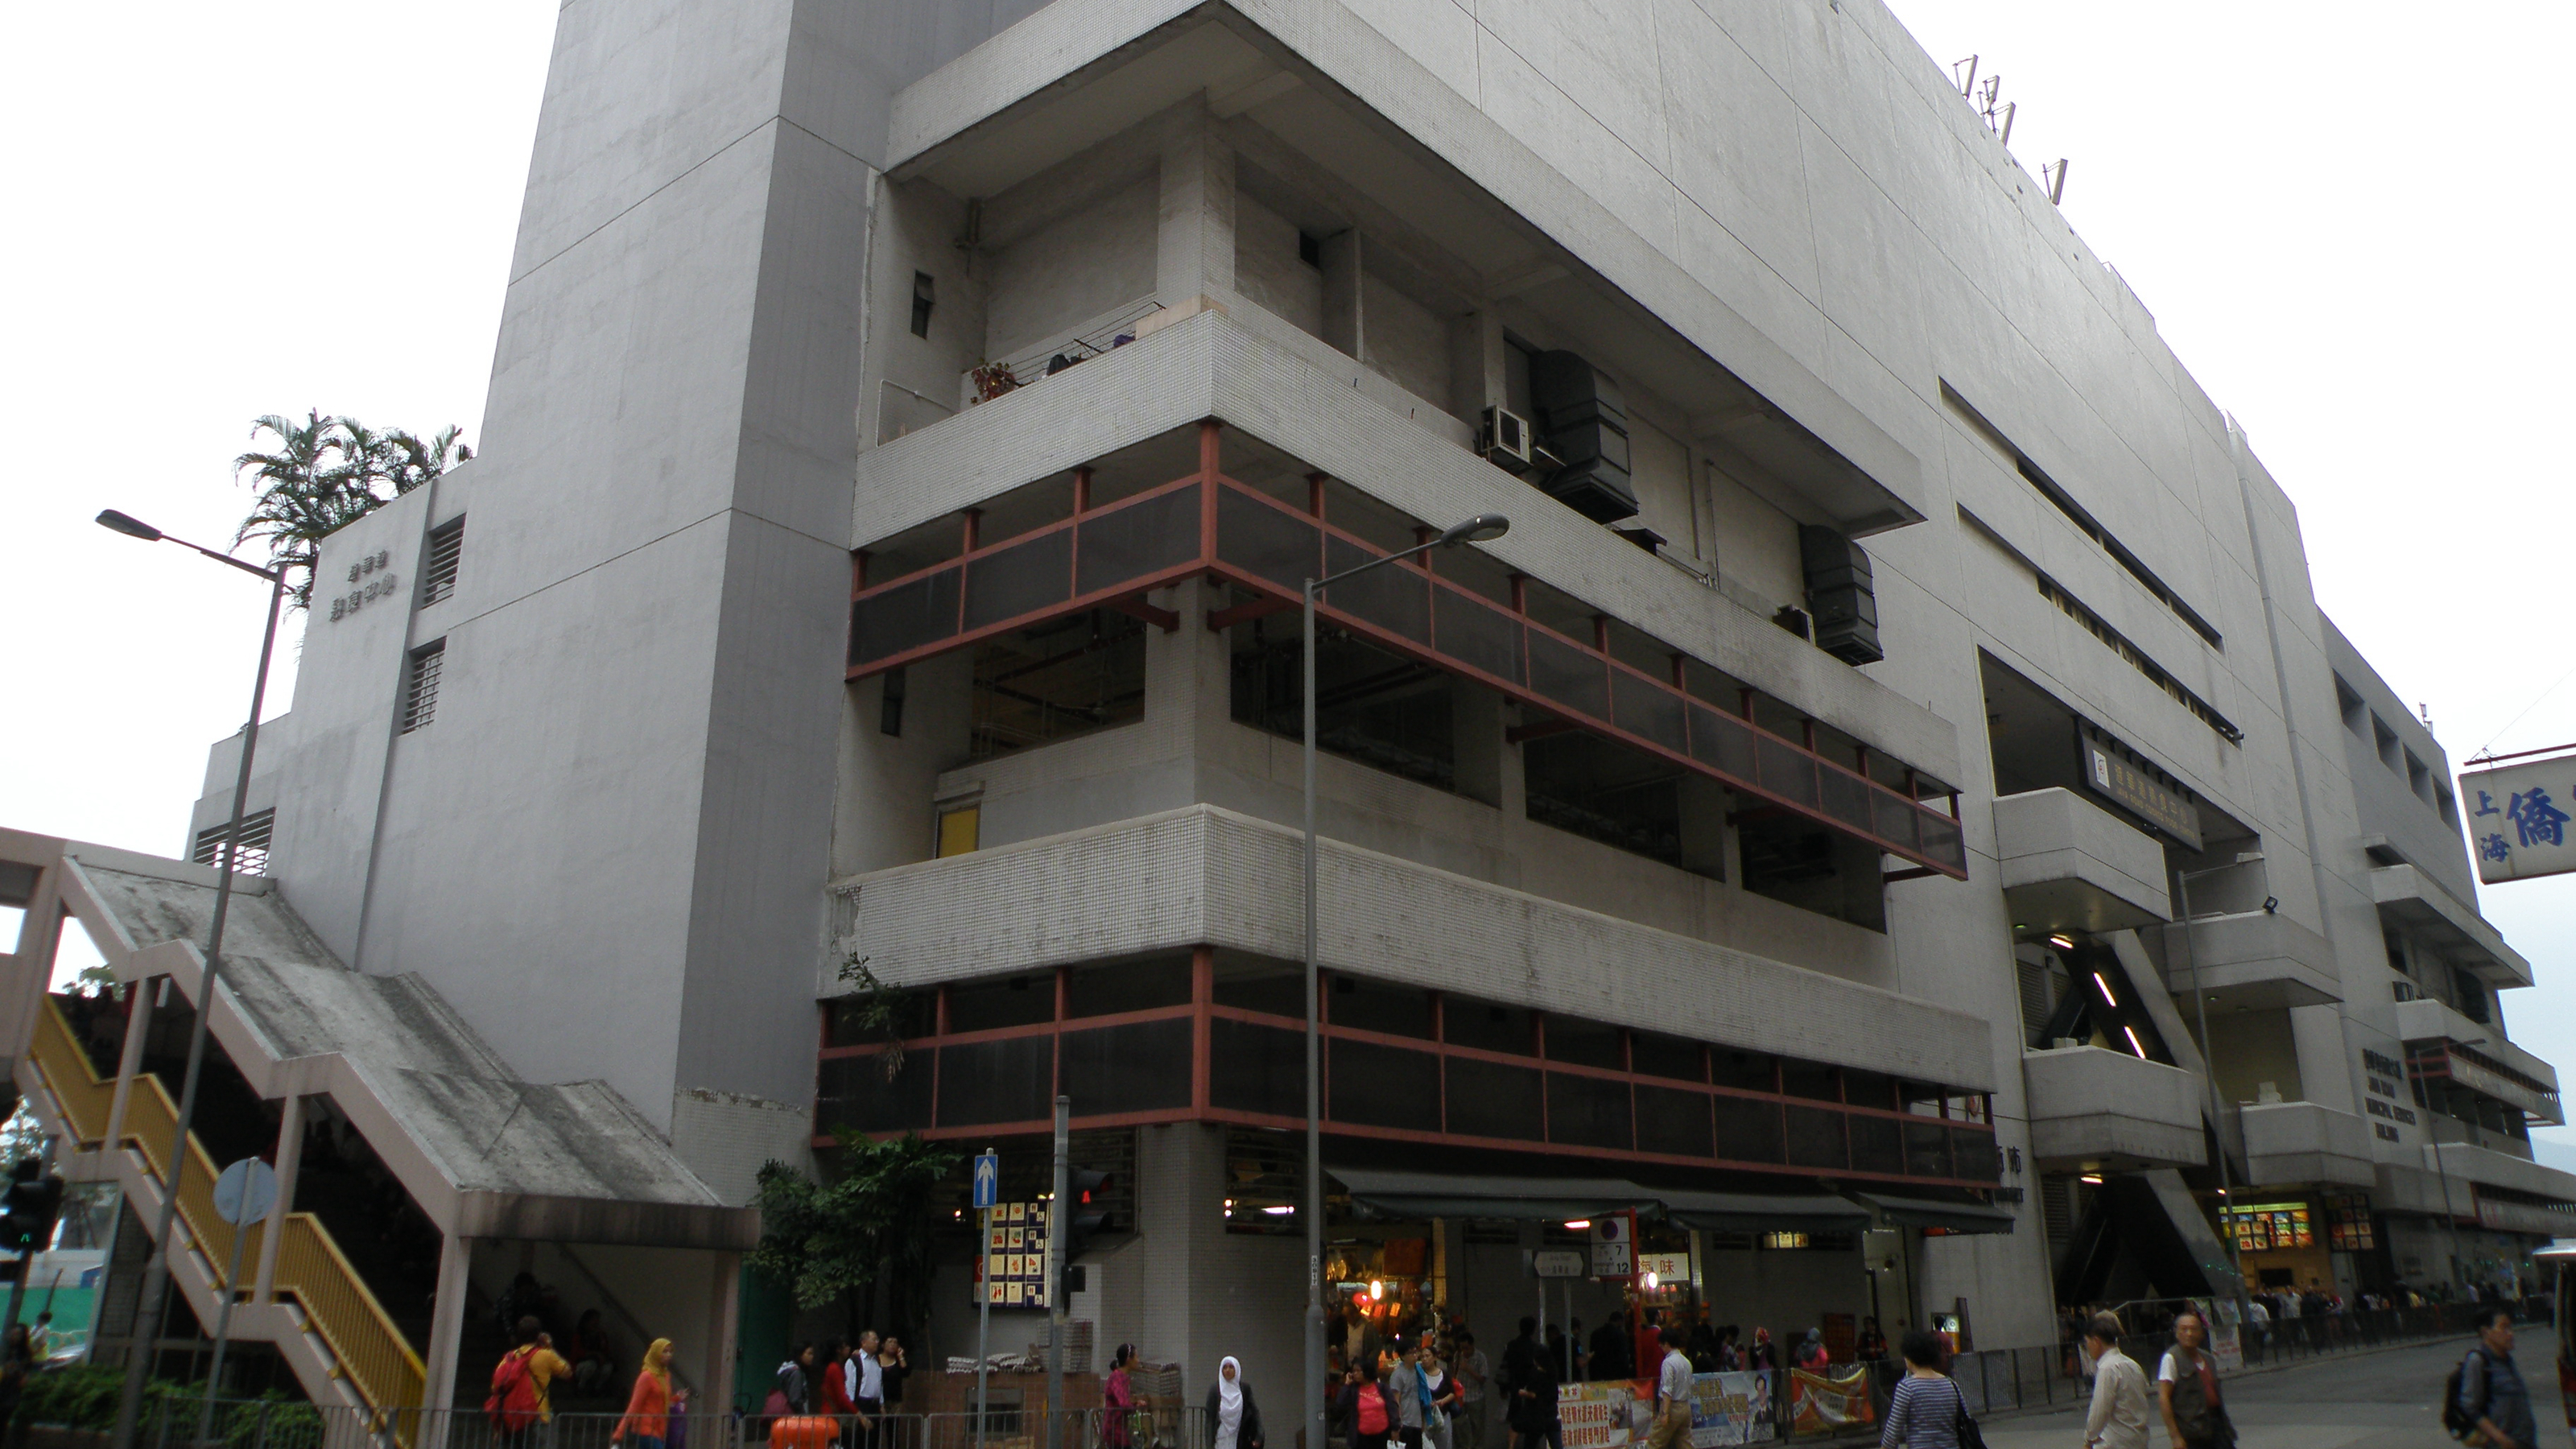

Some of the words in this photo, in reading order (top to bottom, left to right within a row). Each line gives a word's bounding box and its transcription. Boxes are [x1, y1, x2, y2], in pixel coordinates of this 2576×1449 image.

[2475, 790, 2511, 863] 上海
[1616, 1245, 1622, 1256] 7
[1616, 1262, 1629, 1274] 12
